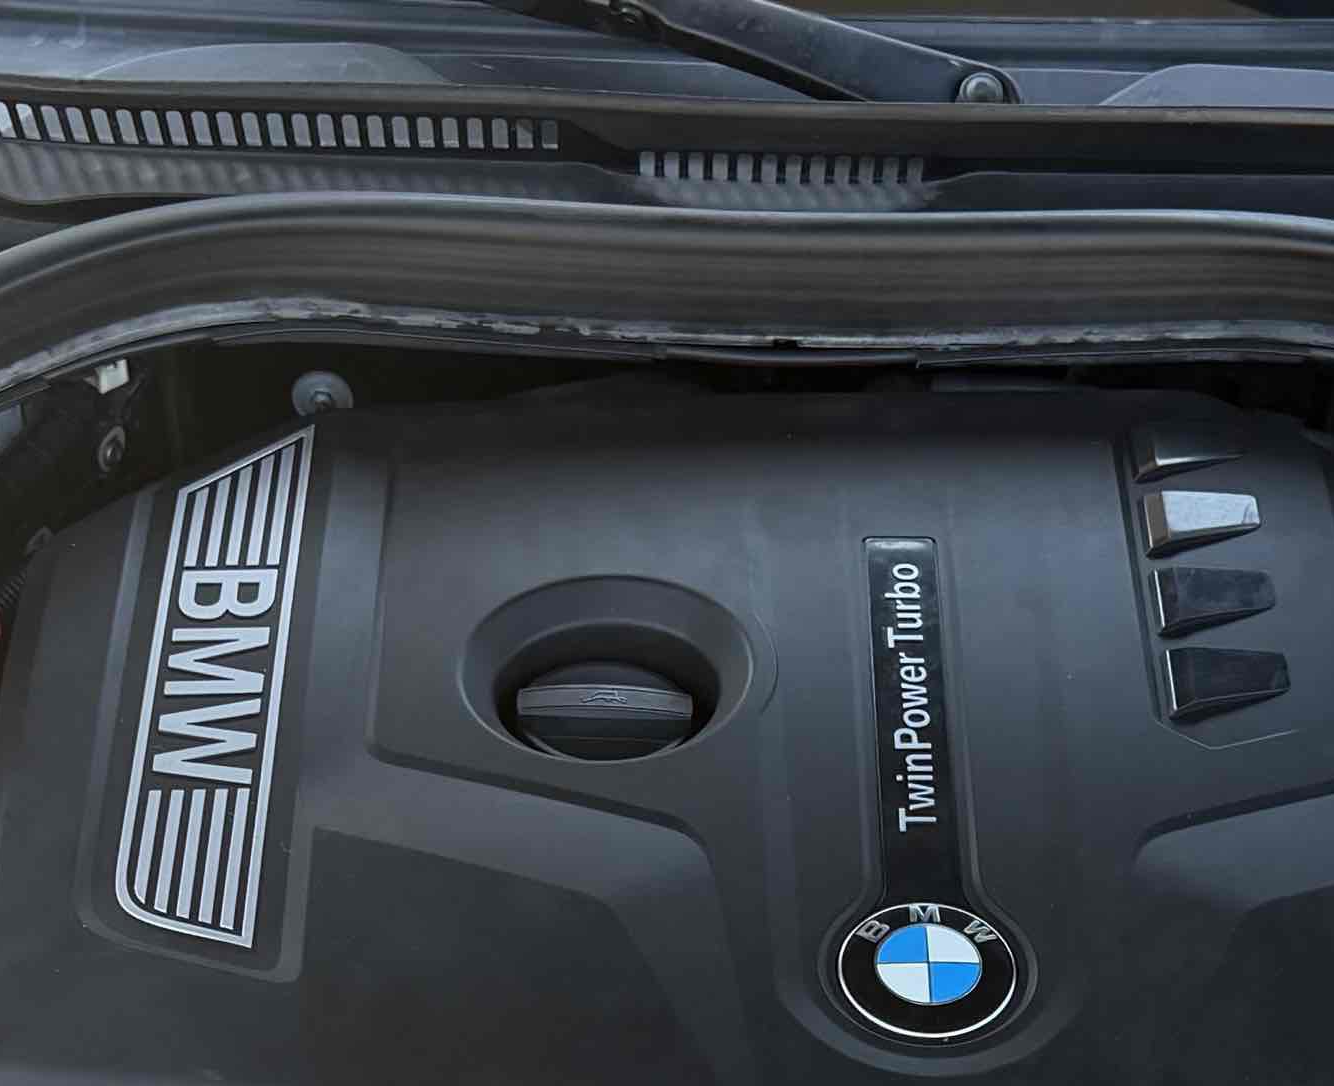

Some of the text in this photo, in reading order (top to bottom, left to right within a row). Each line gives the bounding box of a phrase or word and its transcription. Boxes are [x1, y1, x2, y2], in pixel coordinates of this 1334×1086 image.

[884, 562, 924, 648] Turbo
[152, 569, 279, 785] BMW
[856, 904, 997, 944] BMW
